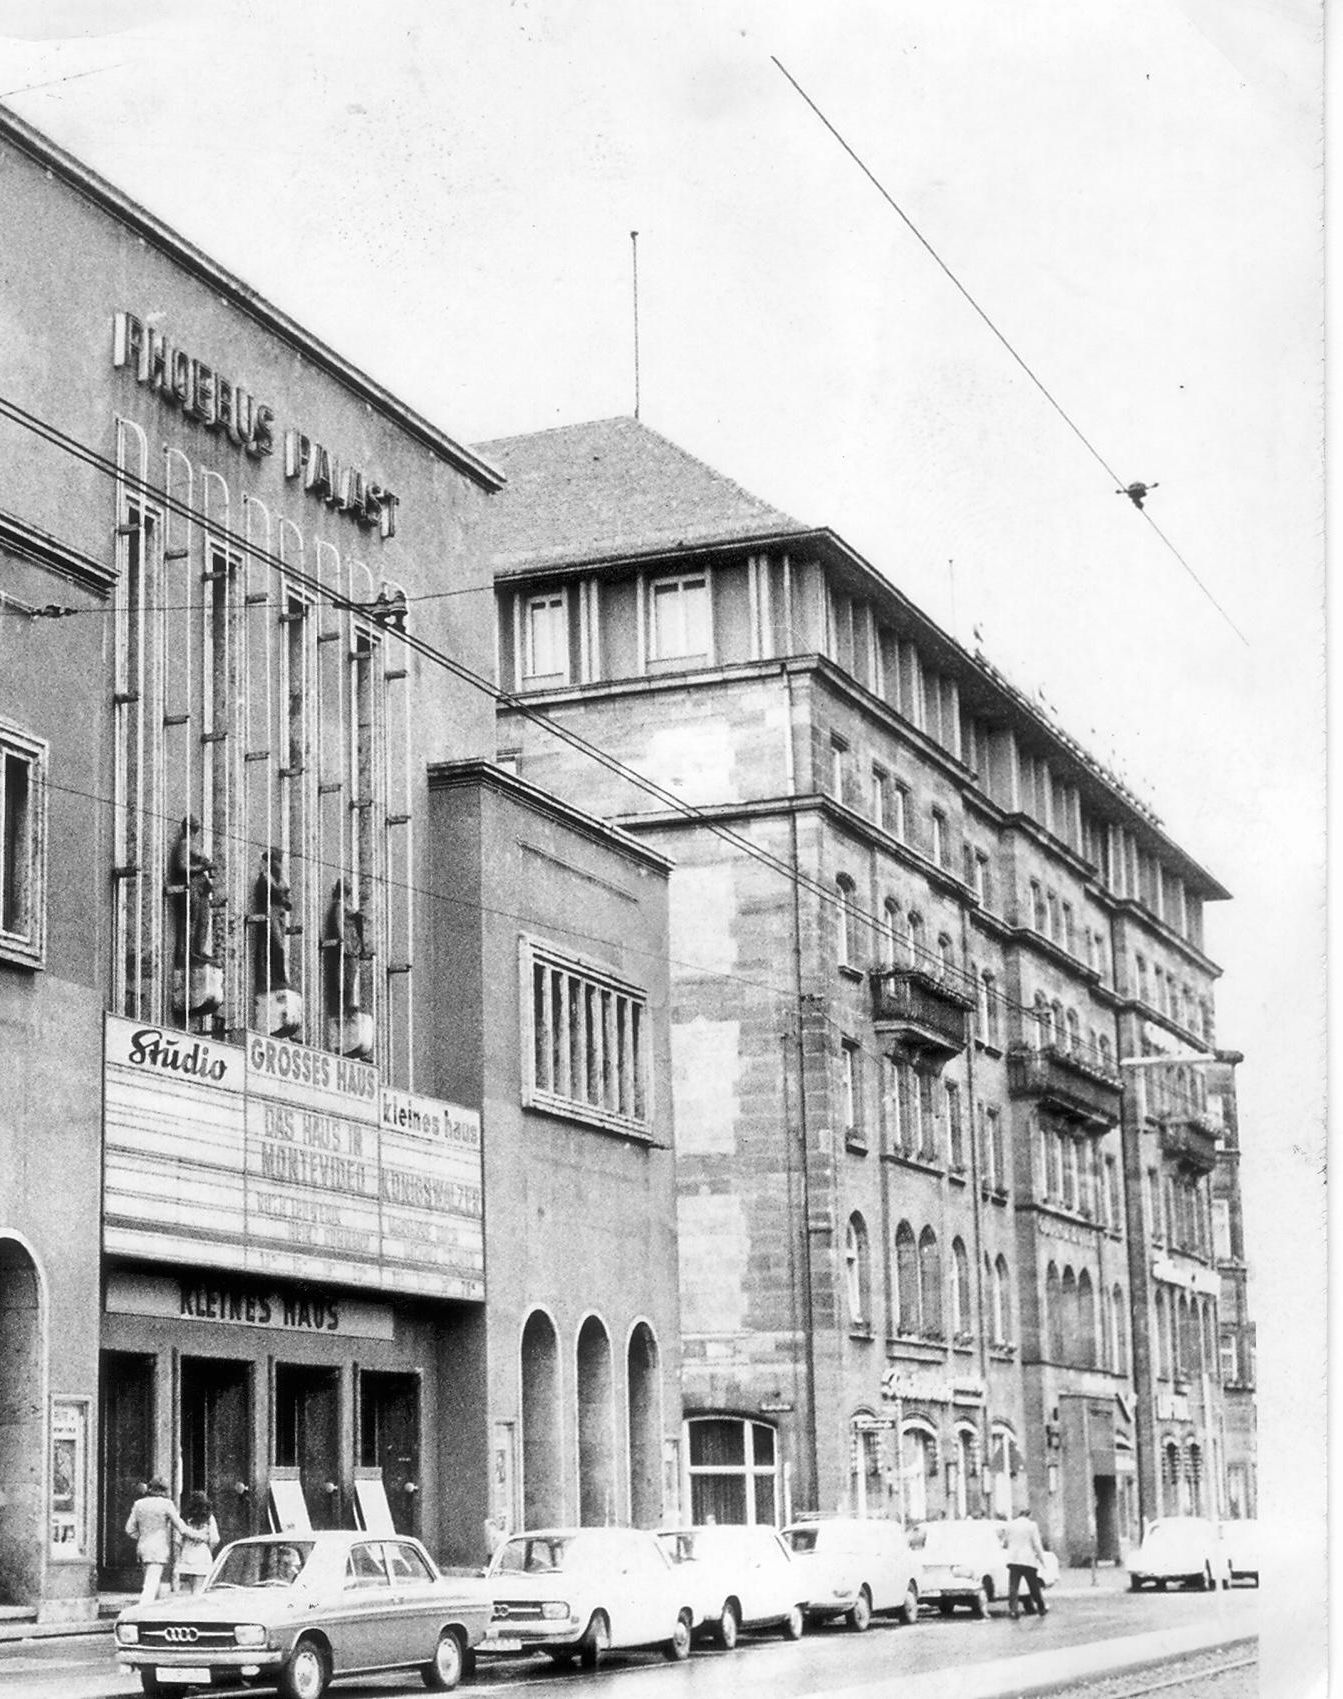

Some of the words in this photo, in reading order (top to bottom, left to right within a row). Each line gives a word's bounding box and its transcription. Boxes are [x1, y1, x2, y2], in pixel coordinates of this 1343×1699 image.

[113, 311, 275, 456] PHOEBUS
[284, 429, 400, 539] PALAST
[128, 1029, 228, 1081] Studio
[251, 1038, 330, 1088] GROSSES
[337, 1060, 375, 1100] HAUS
[263, 1104, 294, 1142] DAS
[302, 1112, 341, 1153] HAUS
[383, 1092, 440, 1136] kleines
[444, 1109, 477, 1144] haus
[180, 1286, 271, 1324] KLEINES
[283, 1297, 339, 1331] HAUS
